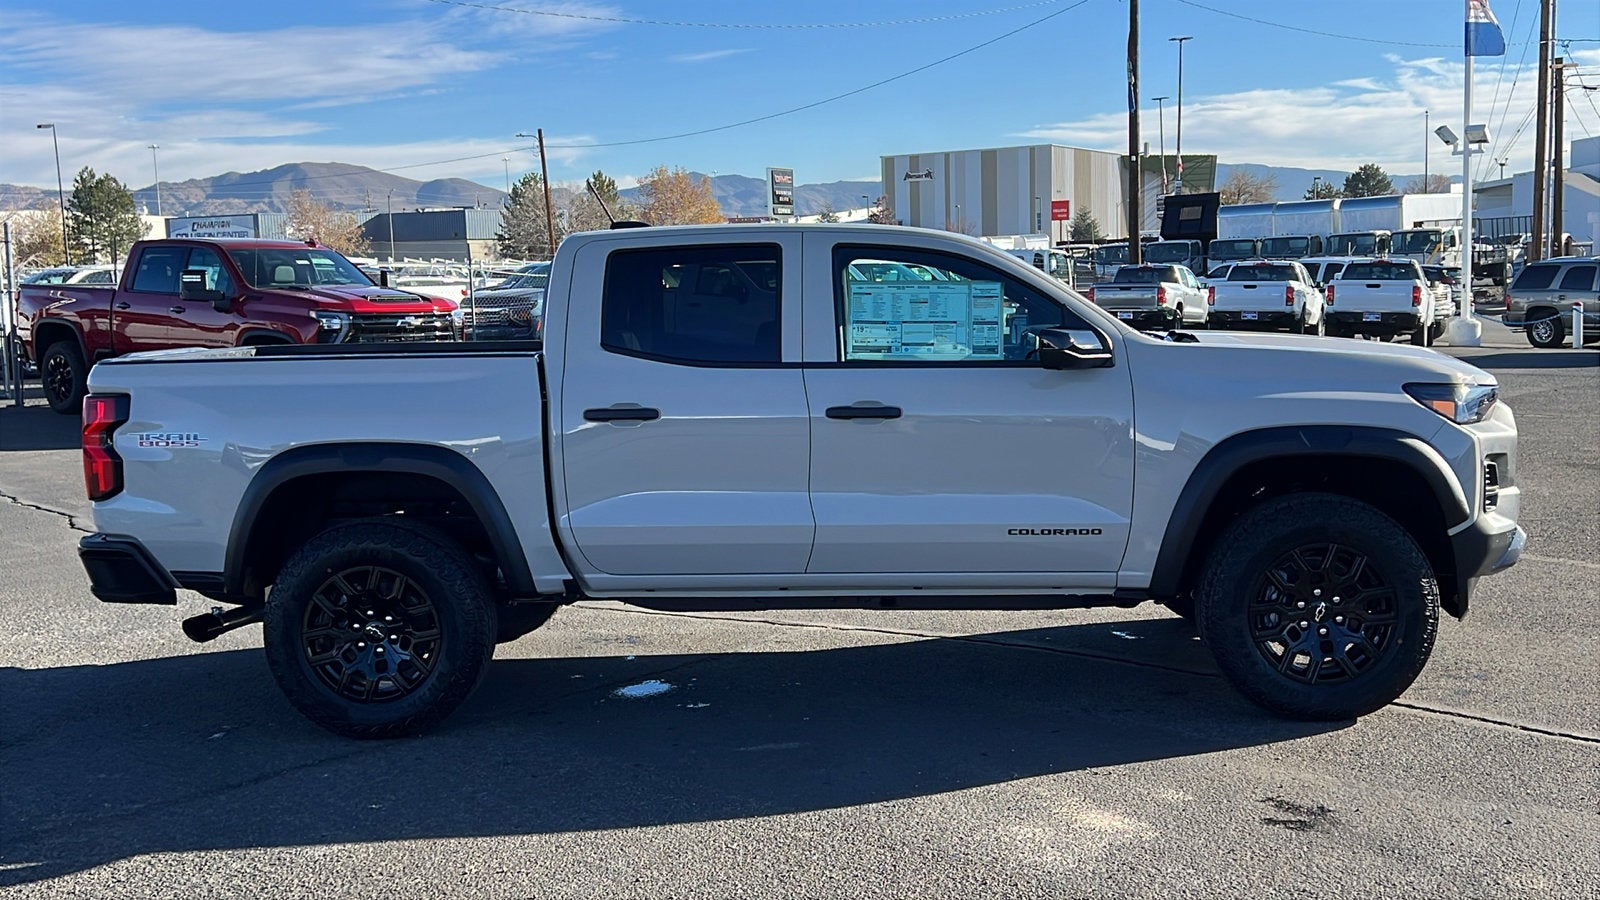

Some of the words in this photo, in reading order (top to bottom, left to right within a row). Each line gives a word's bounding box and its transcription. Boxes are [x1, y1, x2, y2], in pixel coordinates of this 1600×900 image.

[191, 220, 231, 231] CHAMPION
[127, 433, 209, 441] TRAIL
[139, 440, 199, 448] BOSS
[1007, 528, 1103, 536] COLORADO
